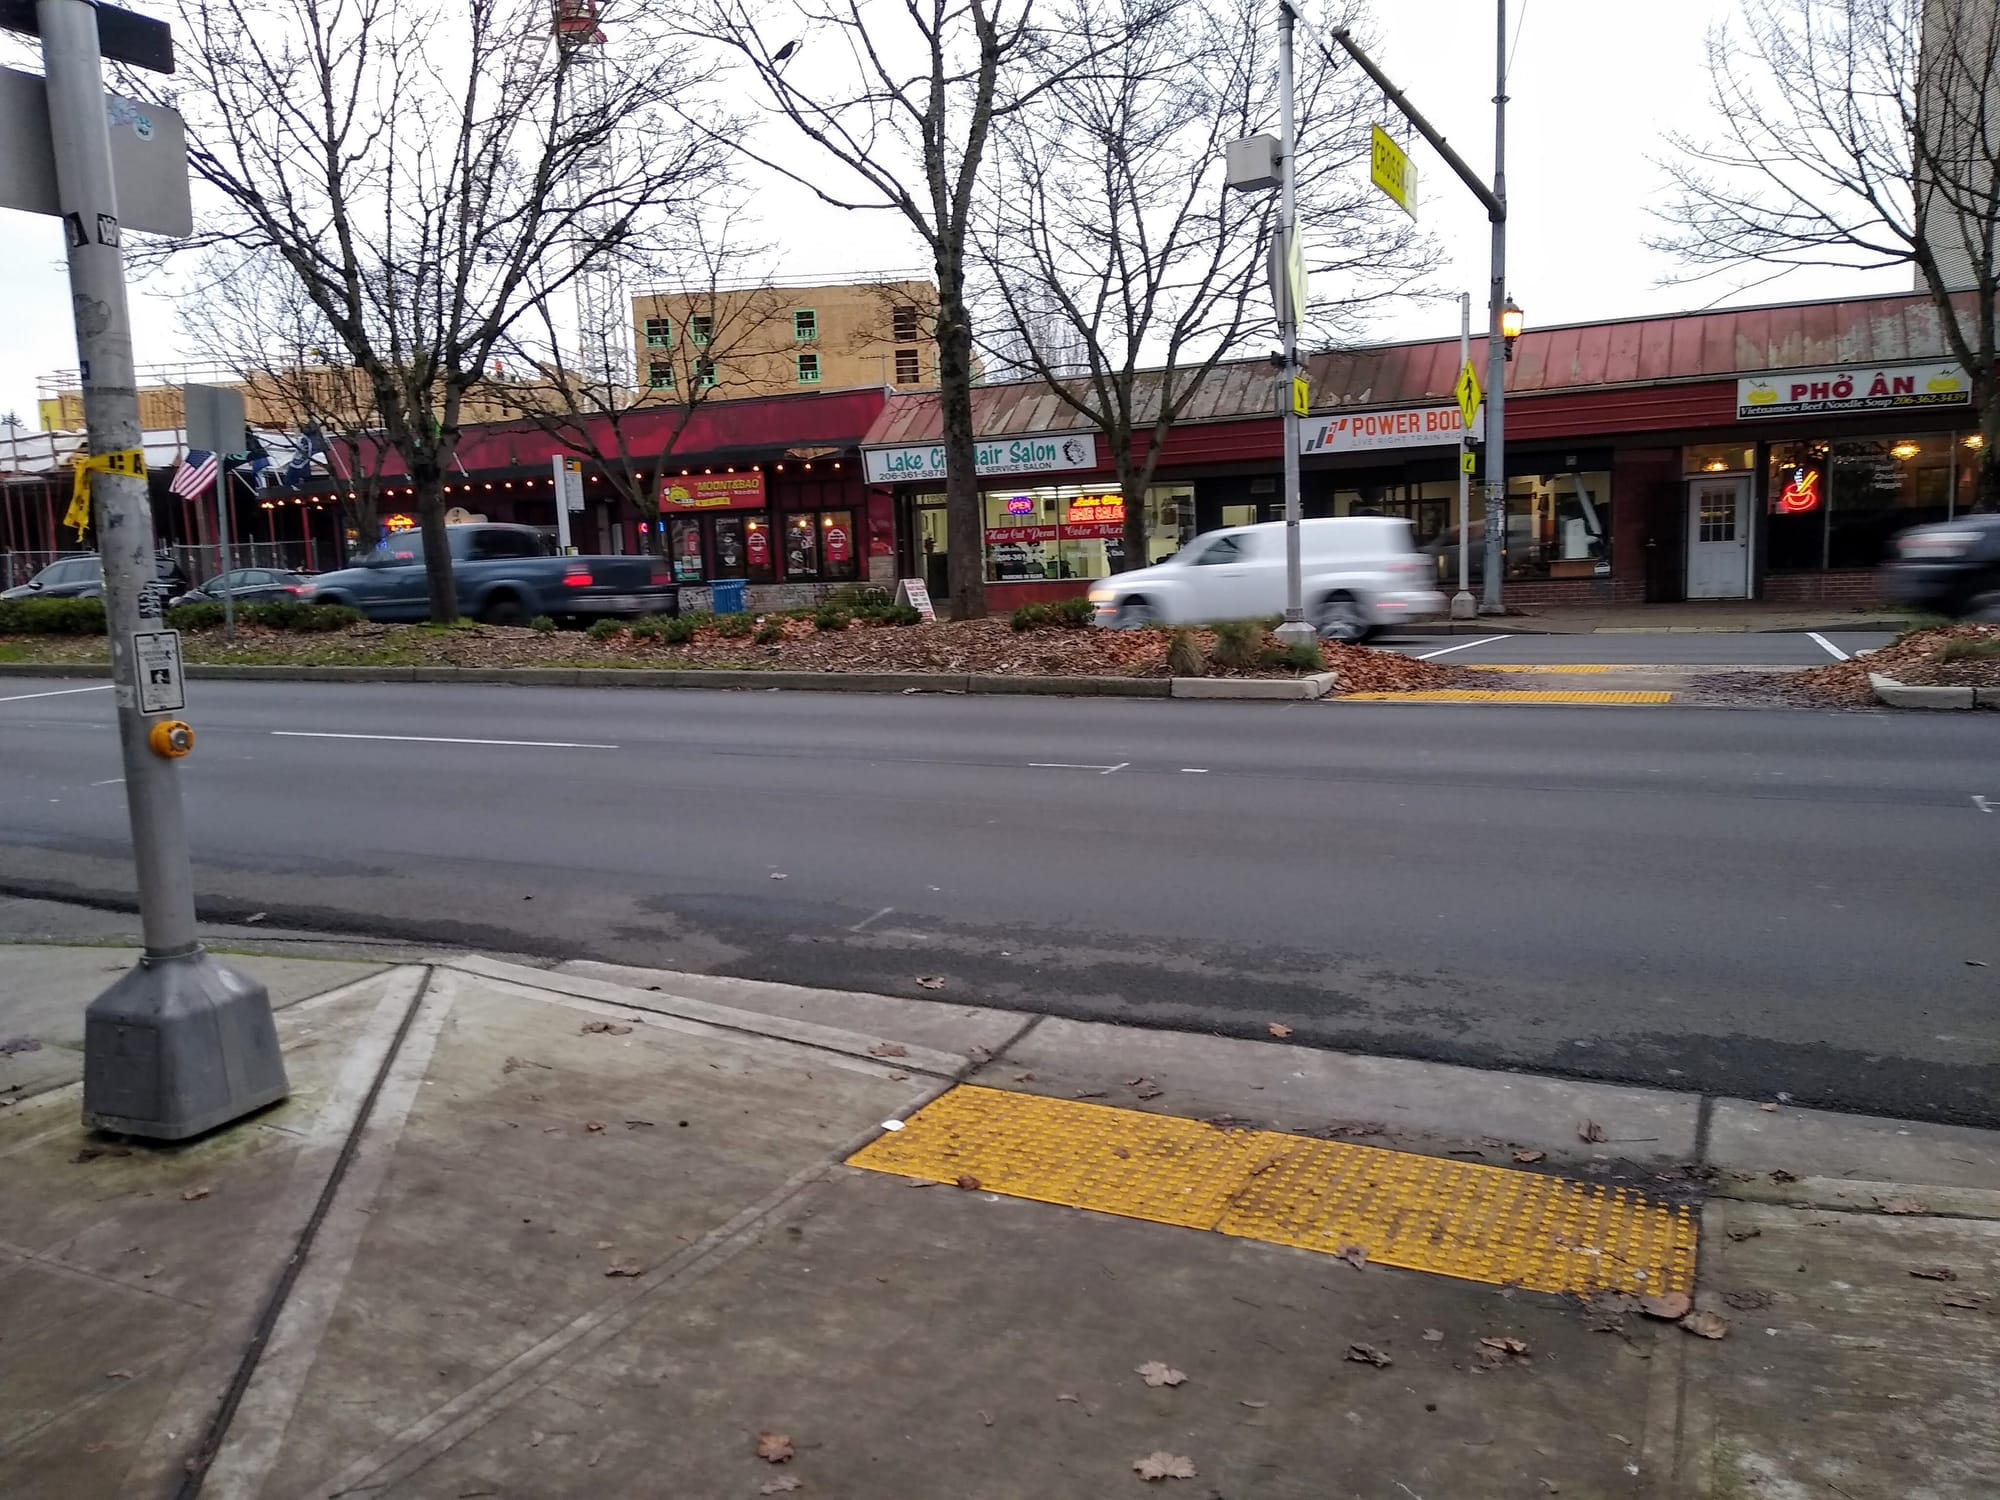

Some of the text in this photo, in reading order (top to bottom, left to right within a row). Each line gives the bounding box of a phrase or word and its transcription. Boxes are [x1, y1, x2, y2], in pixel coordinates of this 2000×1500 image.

[1790, 372, 1915, 401] PHỞ ÂN
[1740, 405, 1799, 416] Vietnamese
[1801, 402, 1824, 412] Beef
[1825, 398, 1864, 411] Noodle
[1864, 397, 1892, 408] Soup
[1352, 410, 1461, 437] POWER BOD
[1352, 437, 1373, 447] LIVE
[1377, 434, 1406, 444] RIGHT
[1411, 431, 1441, 441] TRAIN
[886, 450, 924, 471] Lake
[1009, 440, 1056, 464] Salon
[879, 469, 946, 481] 206-361-5878
[986, 464, 1020, 474] SERVICE
[1023, 462, 1052, 471] SALON
[1009, 502, 1032, 513] OPEN
[1069, 508, 1094, 521] HAIR
